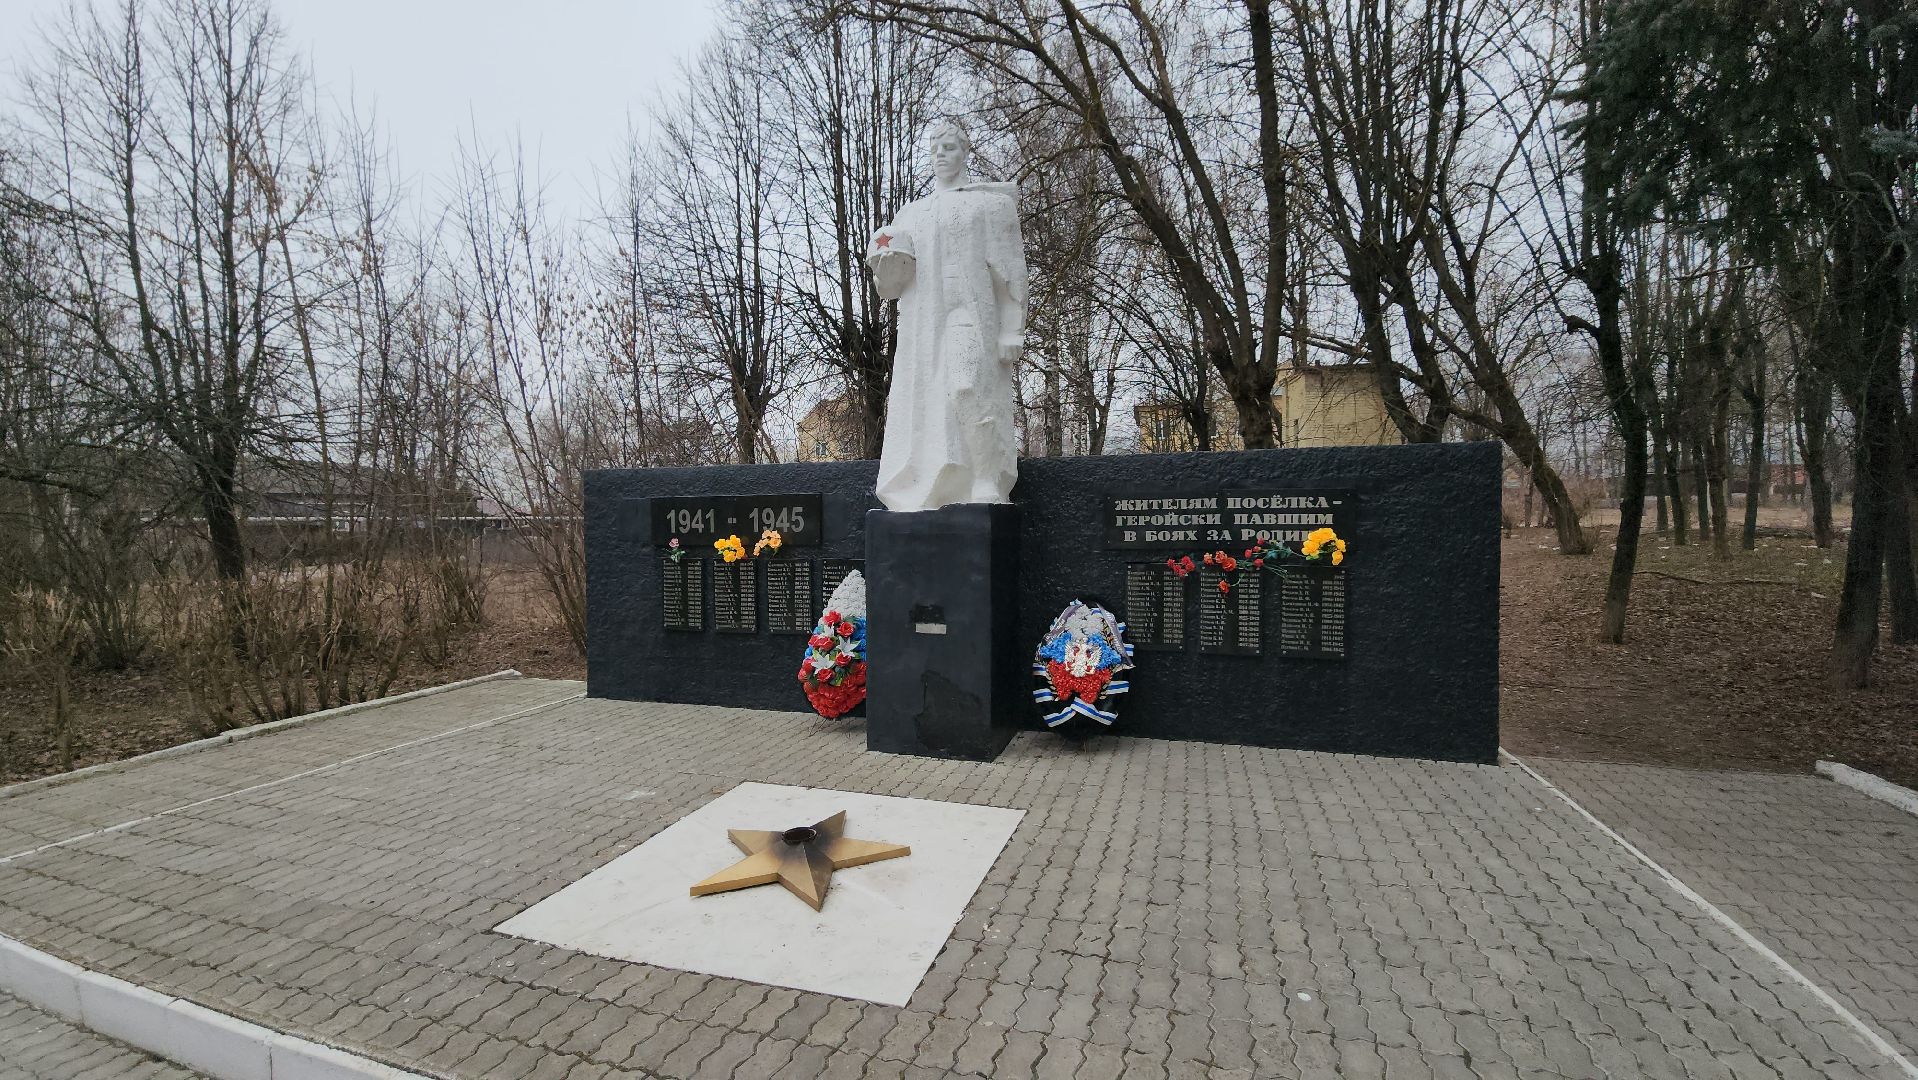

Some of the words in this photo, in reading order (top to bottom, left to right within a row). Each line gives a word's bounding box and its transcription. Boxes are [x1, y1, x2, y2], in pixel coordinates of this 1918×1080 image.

[1114, 497, 1218, 511] ЖИТЕЛЯМ
[1227, 494, 1330, 509] ПОСЁЛКА
[666, 508, 715, 534] 1941
[749, 507, 805, 533] 1945
[1115, 511, 1222, 526] ГЕРОЙСКИ
[1234, 513, 1334, 525] ПАВШИМ
[1124, 531, 1137, 542] В
[1145, 529, 1198, 542] БОЯХ
[1206, 530, 1233, 541] ЗА
[1241, 528, 1311, 542] РОДИ
